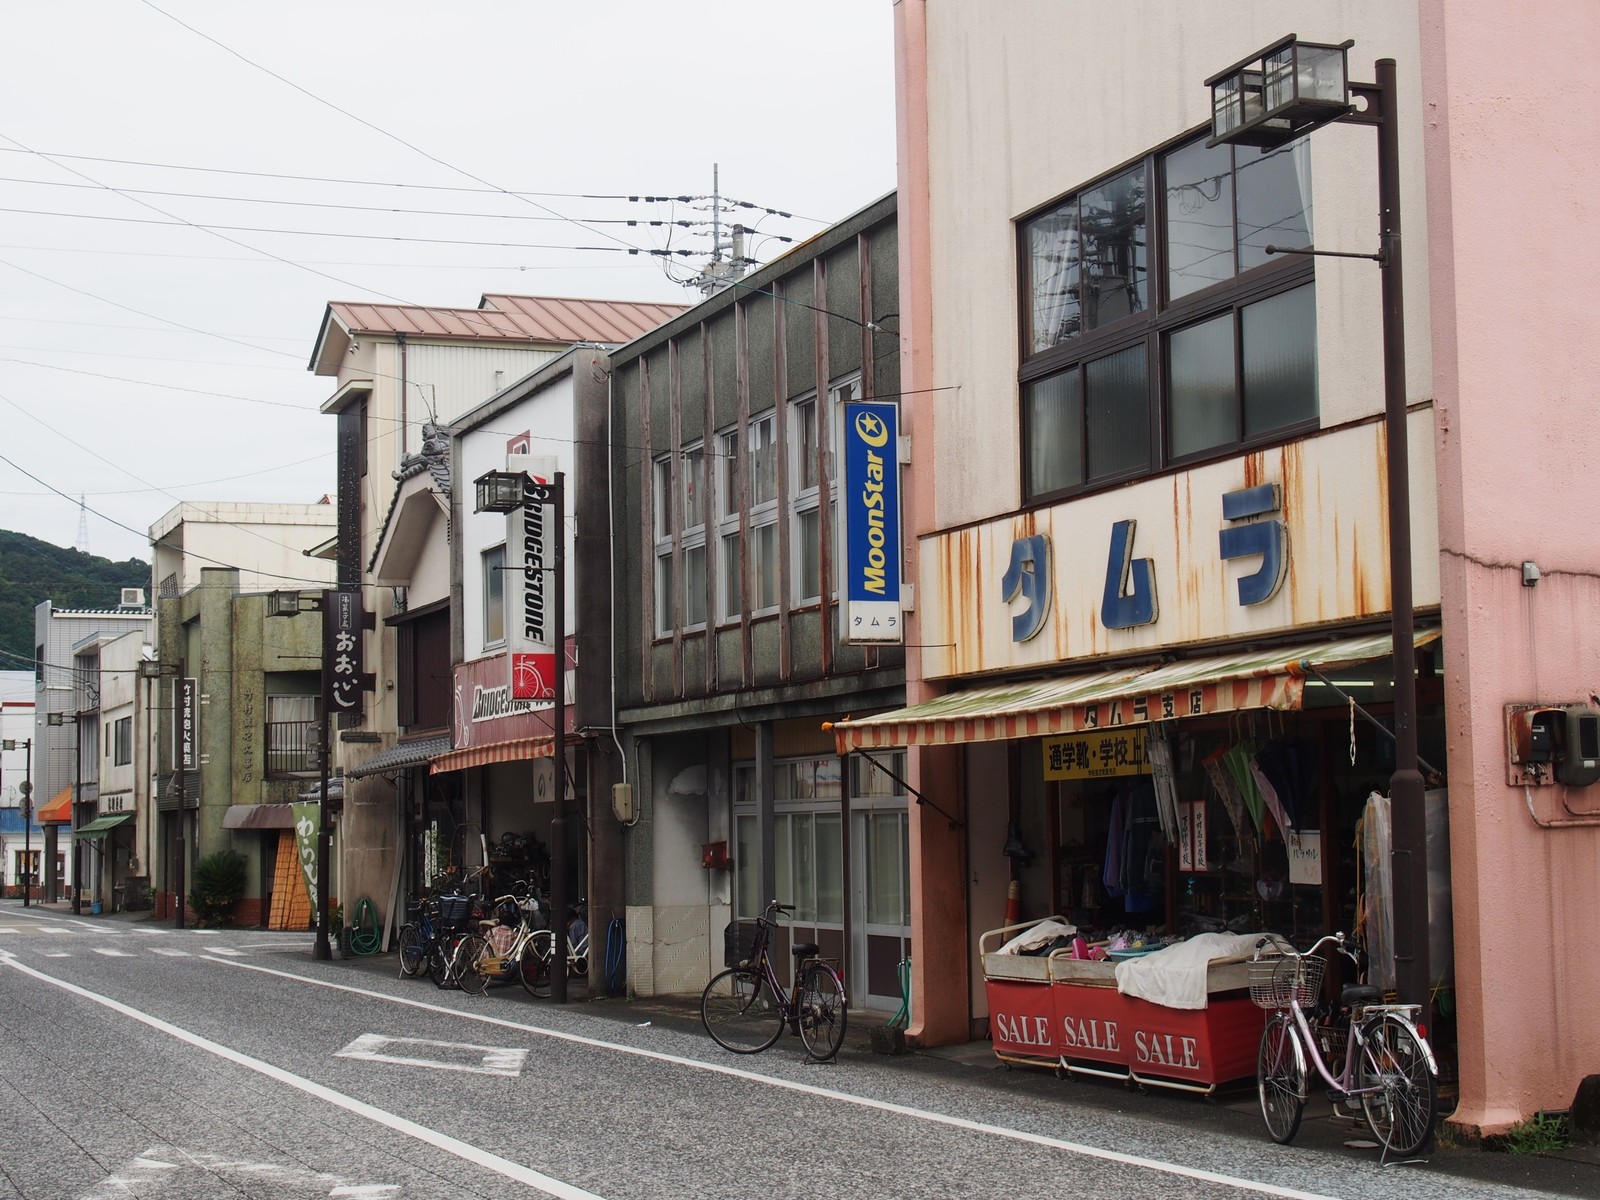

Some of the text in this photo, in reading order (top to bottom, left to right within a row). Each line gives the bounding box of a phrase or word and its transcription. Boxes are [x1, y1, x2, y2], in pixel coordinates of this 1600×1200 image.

[863, 450, 886, 594] MoonStar
[1001, 482, 1291, 644] タムラ
[853, 616, 897, 627] タムラ
[1084, 690, 1202, 728] タムラ支店
[996, 1012, 1051, 1046] SALE
[1063, 1015, 1120, 1052] SALE
[1134, 1029, 1200, 1070] SALE
